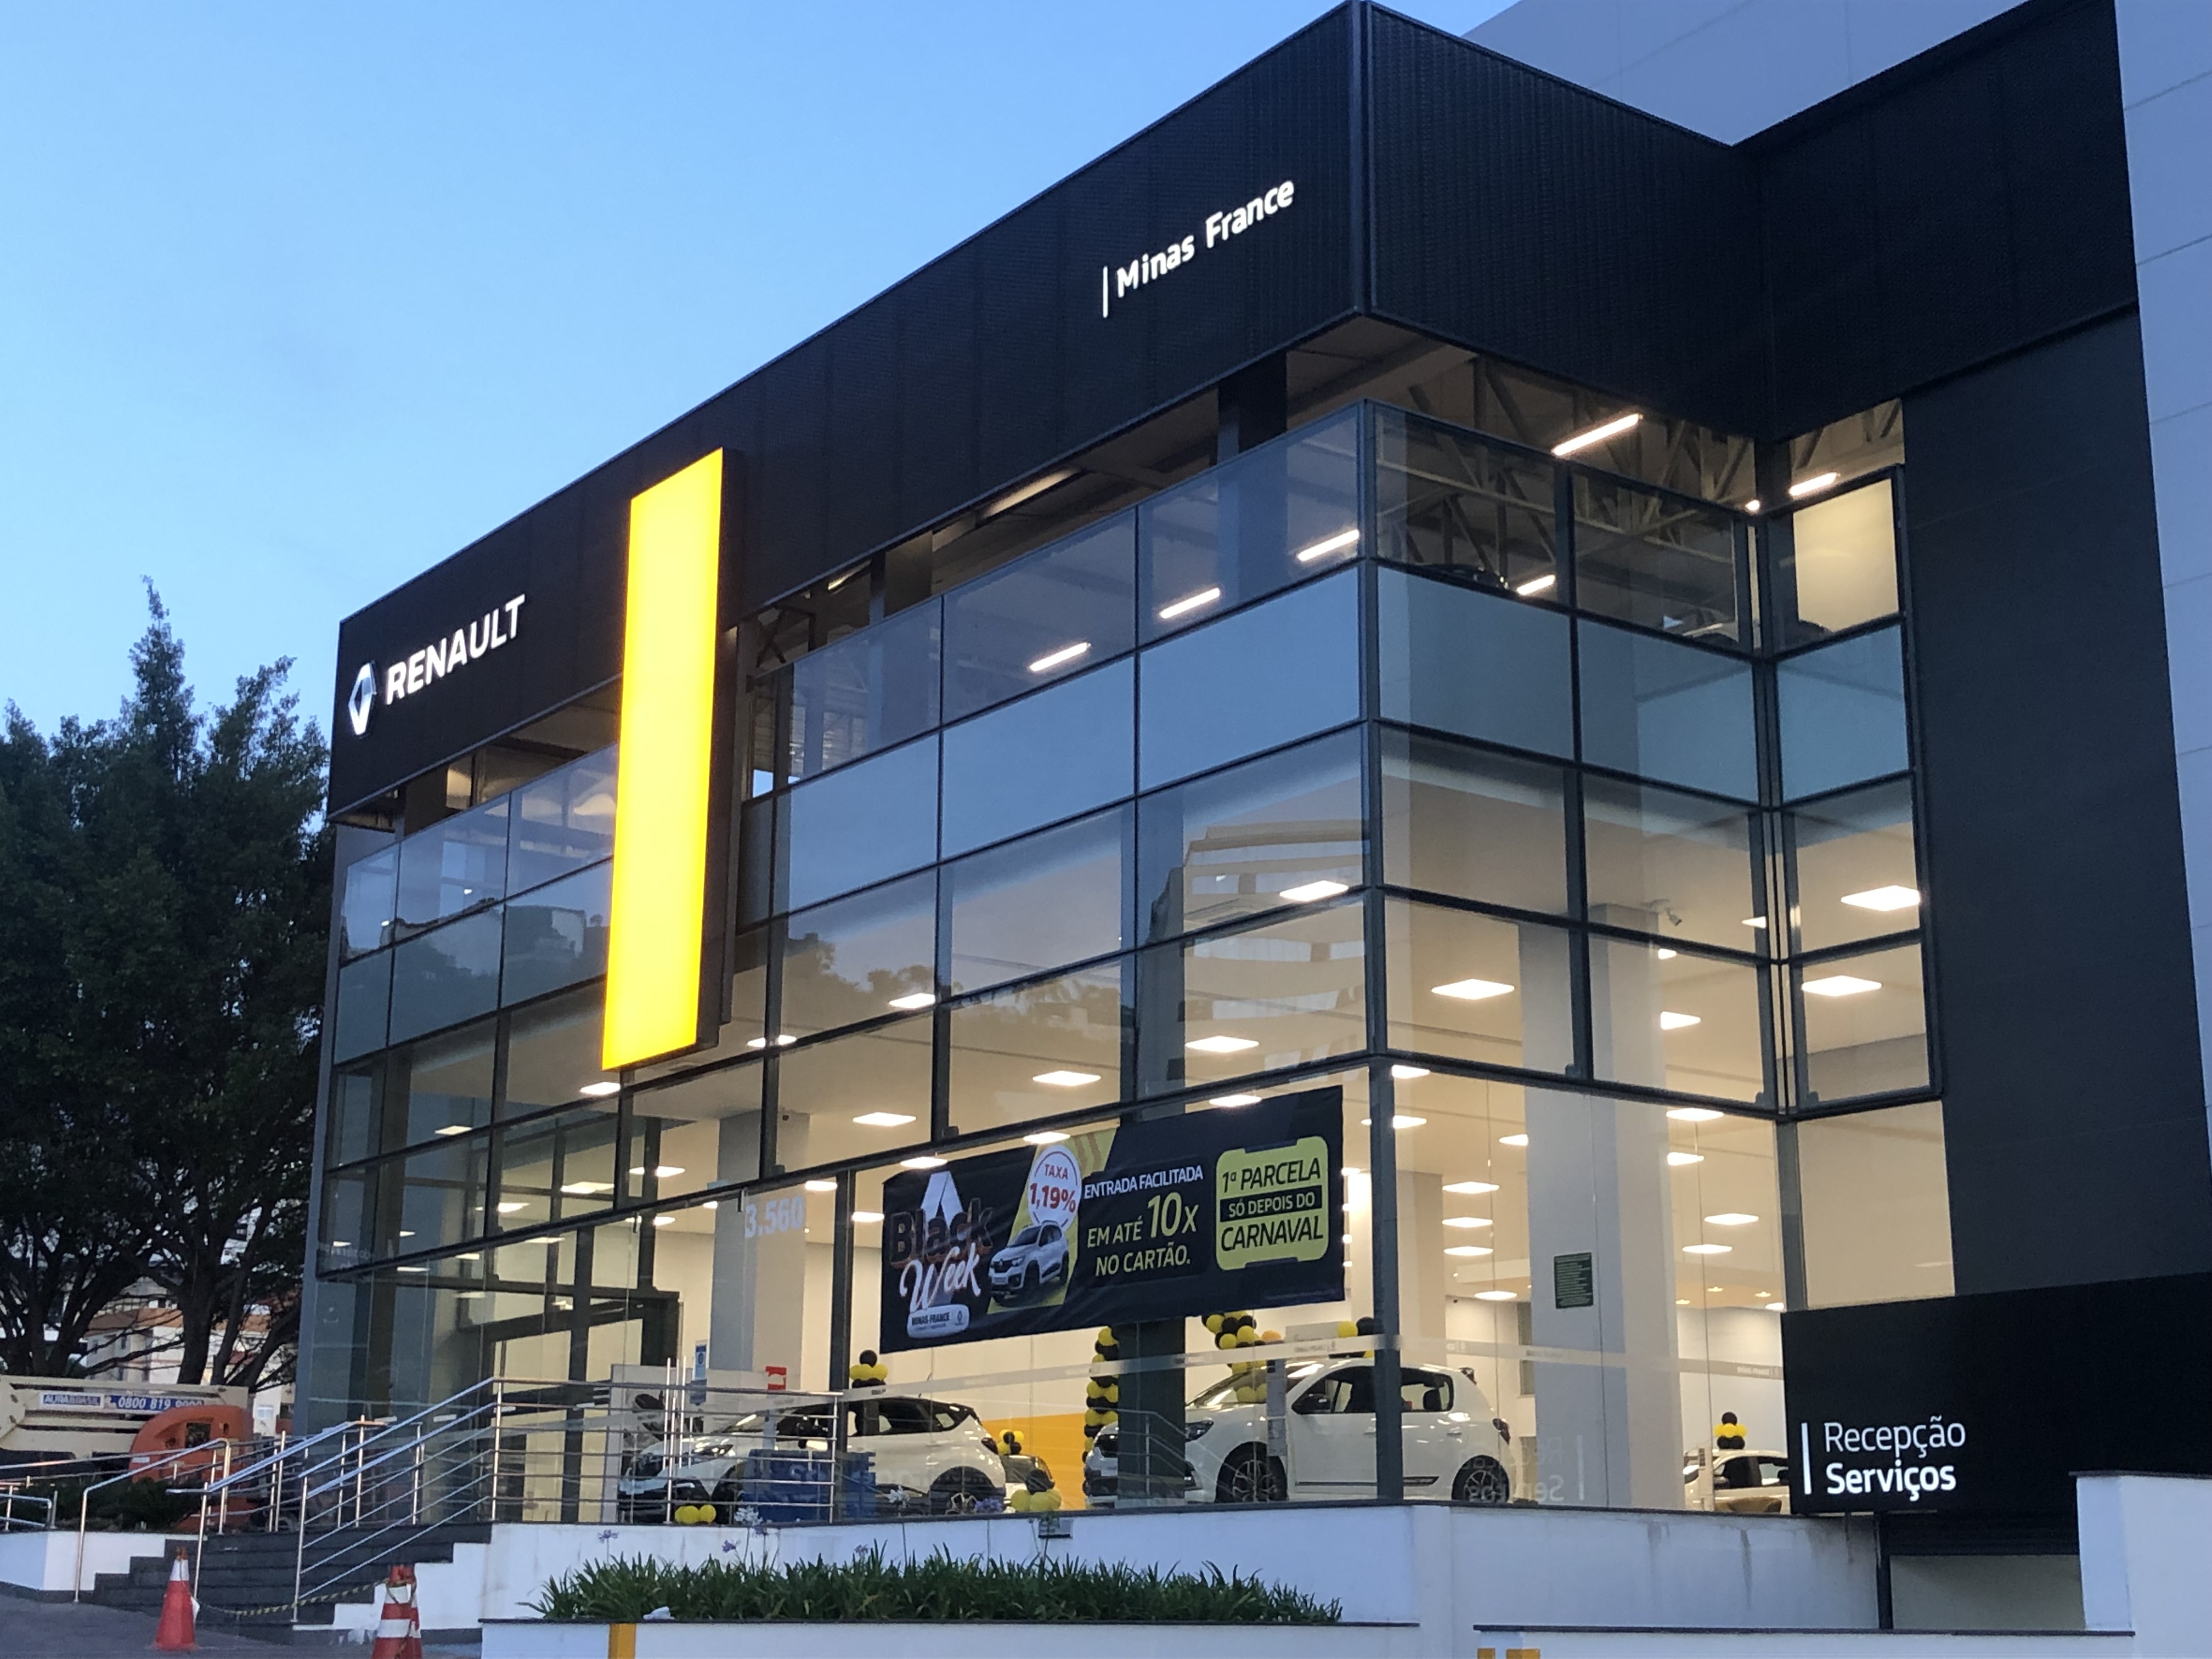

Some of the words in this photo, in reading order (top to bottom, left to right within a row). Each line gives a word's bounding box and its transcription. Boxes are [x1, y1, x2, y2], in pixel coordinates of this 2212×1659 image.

[1116, 234, 1194, 298] Minas
[1205, 179, 1295, 249] France
[385, 593, 526, 705] RENAULT
[1045, 1164, 1068, 1180] TAXA
[1084, 1176, 1138, 1199] ENTRADA
[1139, 1165, 1204, 1189] FACILITADA
[1240, 1158, 1321, 1190] PARCELA
[1030, 1182, 1076, 1214] 1,19%
[1228, 1198, 1245, 1217] SÓ
[1248, 1195, 1294, 1215] DEPOIS
[1296, 1192, 1316, 1208] DO
[744, 1195, 804, 1238] 3.560
[890, 1197, 994, 1265] Black
[1087, 1226, 1110, 1248] EM
[1112, 1215, 1143, 1244] ATÉ
[1221, 1215, 1324, 1251] CARNAVAL
[1095, 1255, 1120, 1277] NO
[1123, 1241, 1191, 1273] CARTÃO.
[899, 1242, 981, 1313] Week
[118, 1396, 146, 1409] 0800
[150, 1398, 171, 1410] 819
[1824, 1415, 1966, 1458] Recepção
[1825, 1459, 1957, 1502] Serviços
